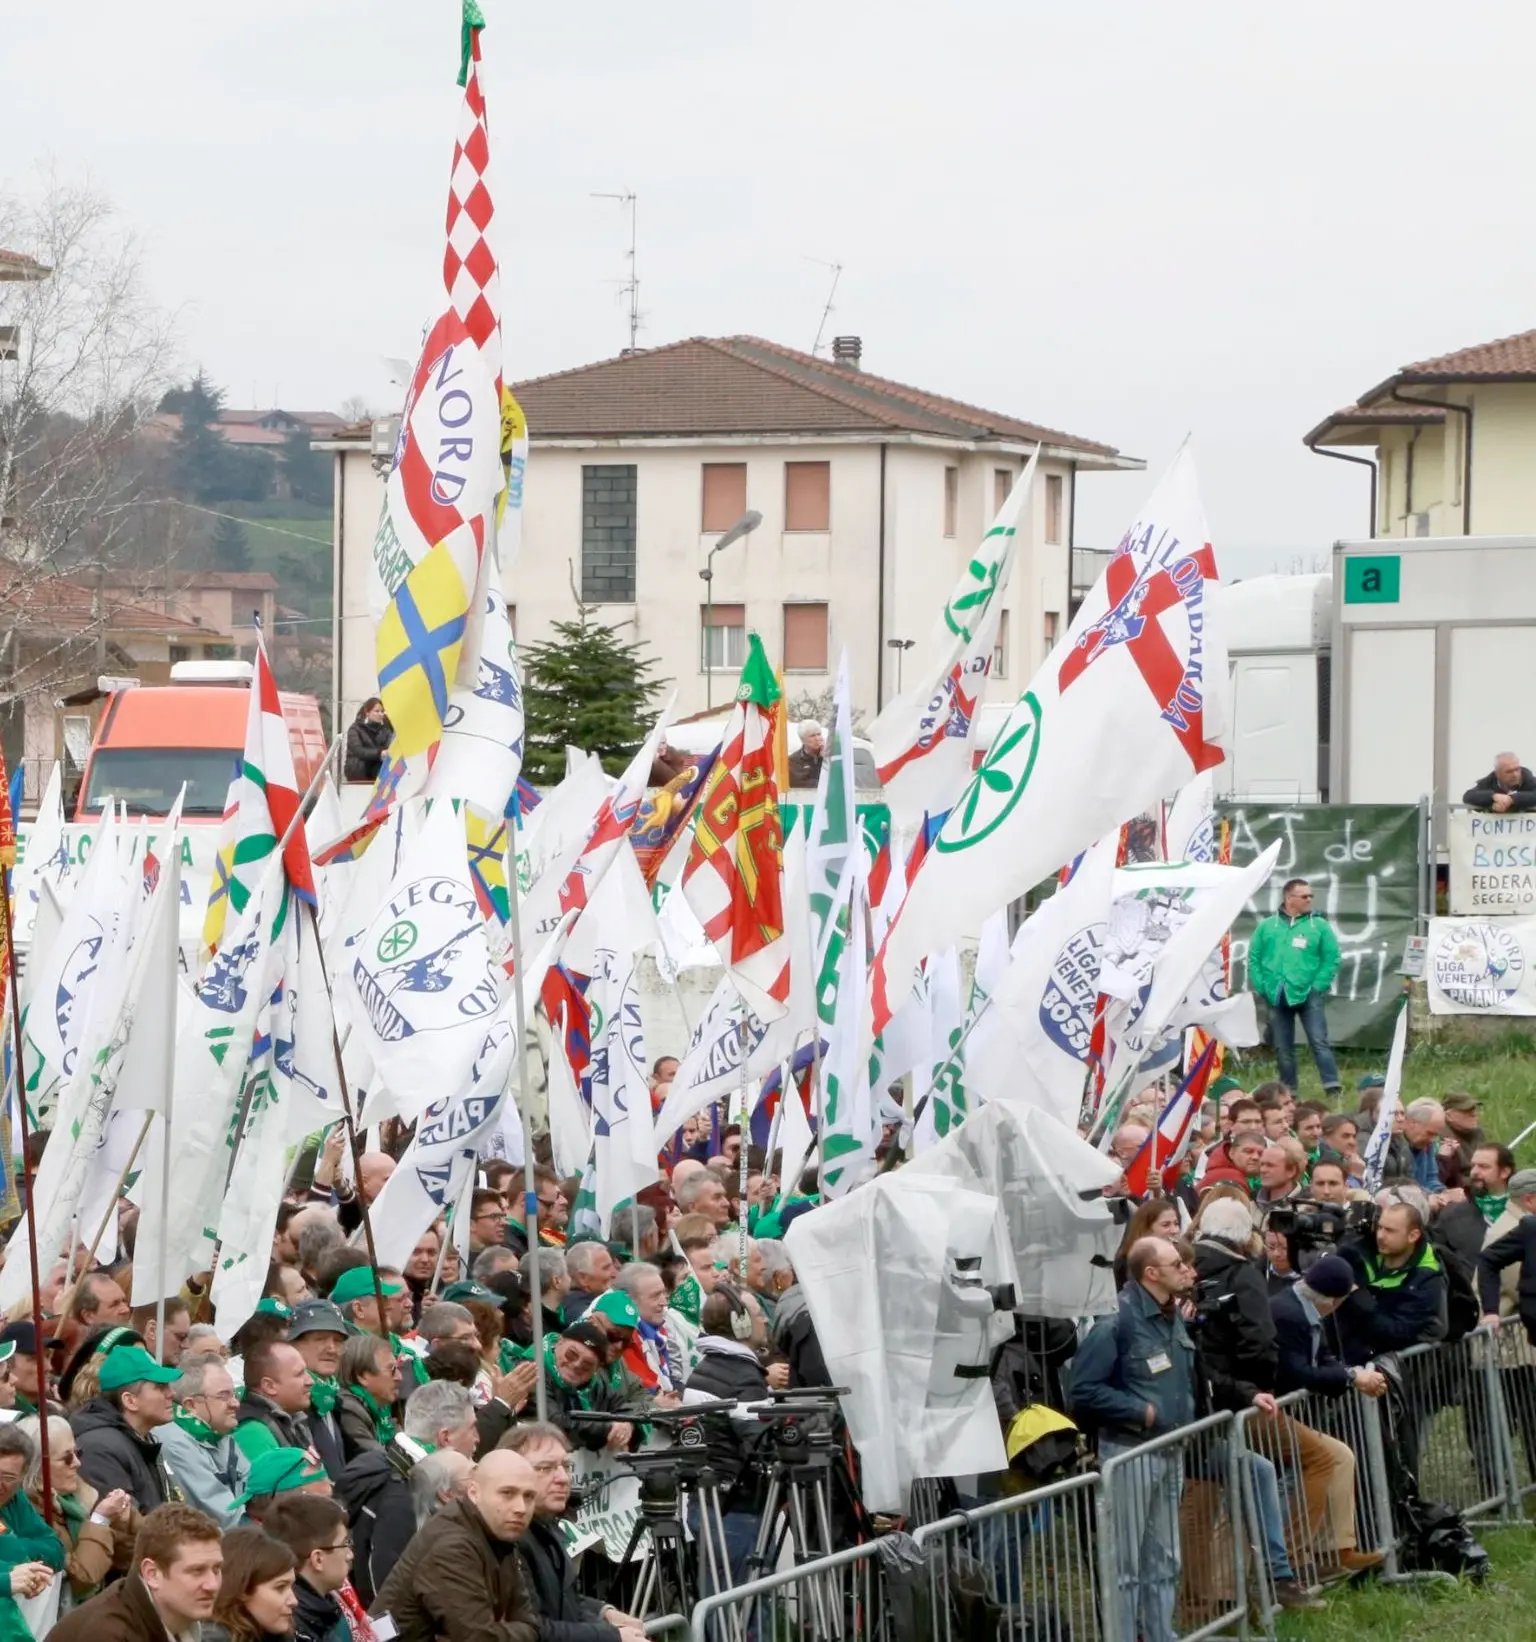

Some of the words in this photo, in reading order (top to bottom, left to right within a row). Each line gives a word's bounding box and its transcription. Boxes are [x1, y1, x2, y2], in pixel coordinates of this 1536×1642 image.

[429, 345, 474, 507] NORD
[1361, 568, 1381, 593] a
[1324, 819, 1373, 862] de
[1472, 873, 1533, 890] FEDERA
[389, 880, 476, 920] LEGA
[1068, 938, 1101, 982] LIGA
[1440, 926, 1478, 960] LEGA
[1486, 925, 1523, 971] NORD
[1436, 962, 1465, 973] LIGA
[1436, 973, 1481, 985] VENETA
[1449, 989, 1508, 1008] PADANIA
